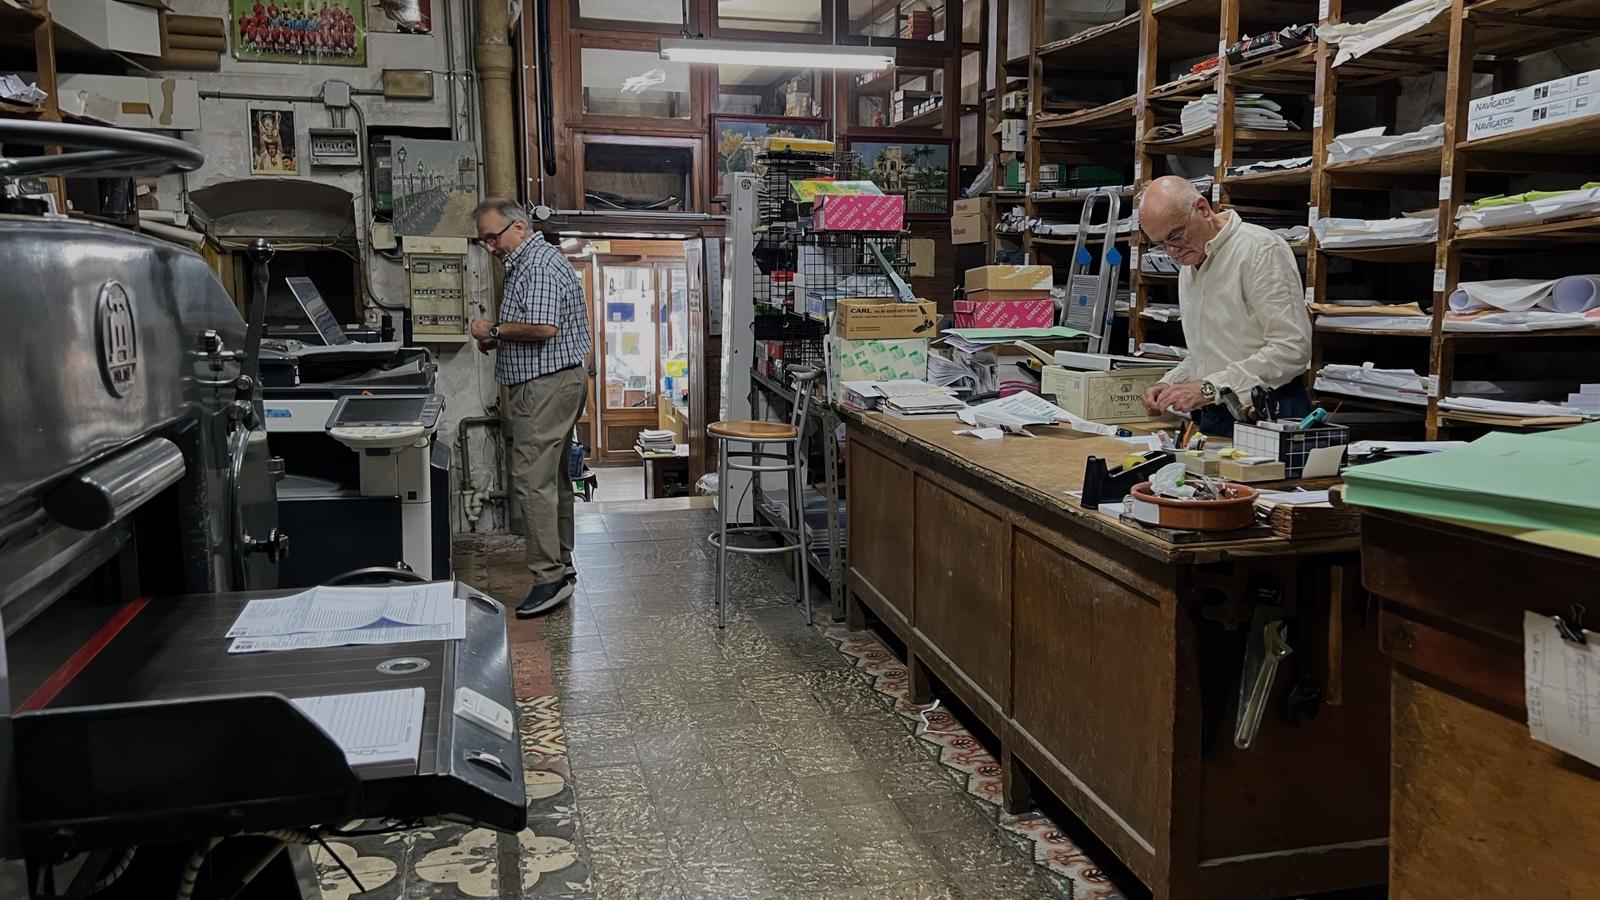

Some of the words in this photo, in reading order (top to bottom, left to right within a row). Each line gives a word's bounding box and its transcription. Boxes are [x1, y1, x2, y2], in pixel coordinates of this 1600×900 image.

[1475, 96, 1515, 111] NAVIGATOR
[1474, 117, 1514, 131] NAVIGATOR
[828, 204, 848, 225] DIRECTO
[838, 206, 859, 227] DIRECTO
[880, 207, 900, 227] DIRECTO
[986, 301, 1006, 323] DIRECTO
[1026, 300, 1047, 321] DIRECTO
